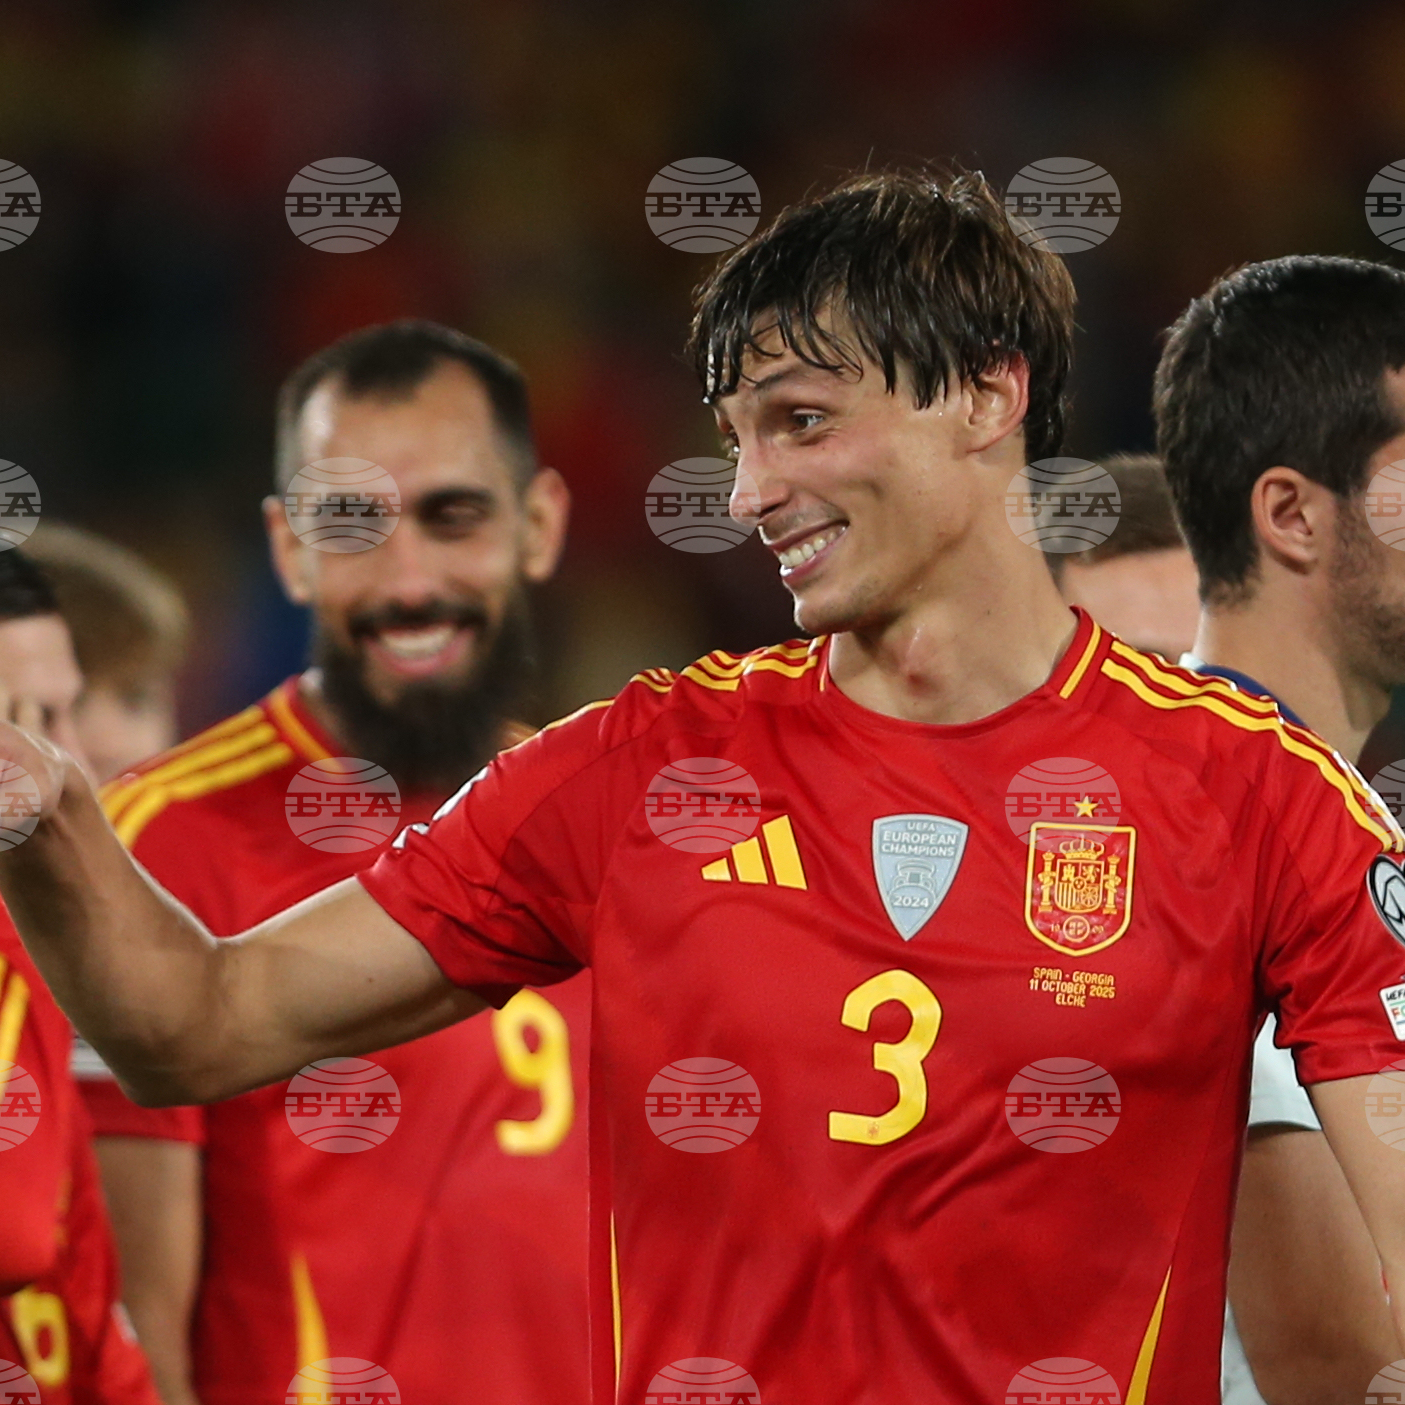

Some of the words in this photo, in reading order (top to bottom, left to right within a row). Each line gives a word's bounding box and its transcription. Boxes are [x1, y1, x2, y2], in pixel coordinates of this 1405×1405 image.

[907, 822, 935, 831] UEFA
[883, 831, 956, 845] EUROPEAN
[881, 843, 955, 857] CHAMPIONS
[893, 896, 929, 908] 2024
[1072, 971, 1115, 986] GEORGIA
[1029, 978, 1039, 991] 11
[1041, 980, 1087, 995] OCTOBER
[1089, 985, 1116, 999] 2025
[1055, 993, 1086, 1008] ELCHE
[828, 969, 942, 1146] 3
[490, 987, 575, 1157] 9
